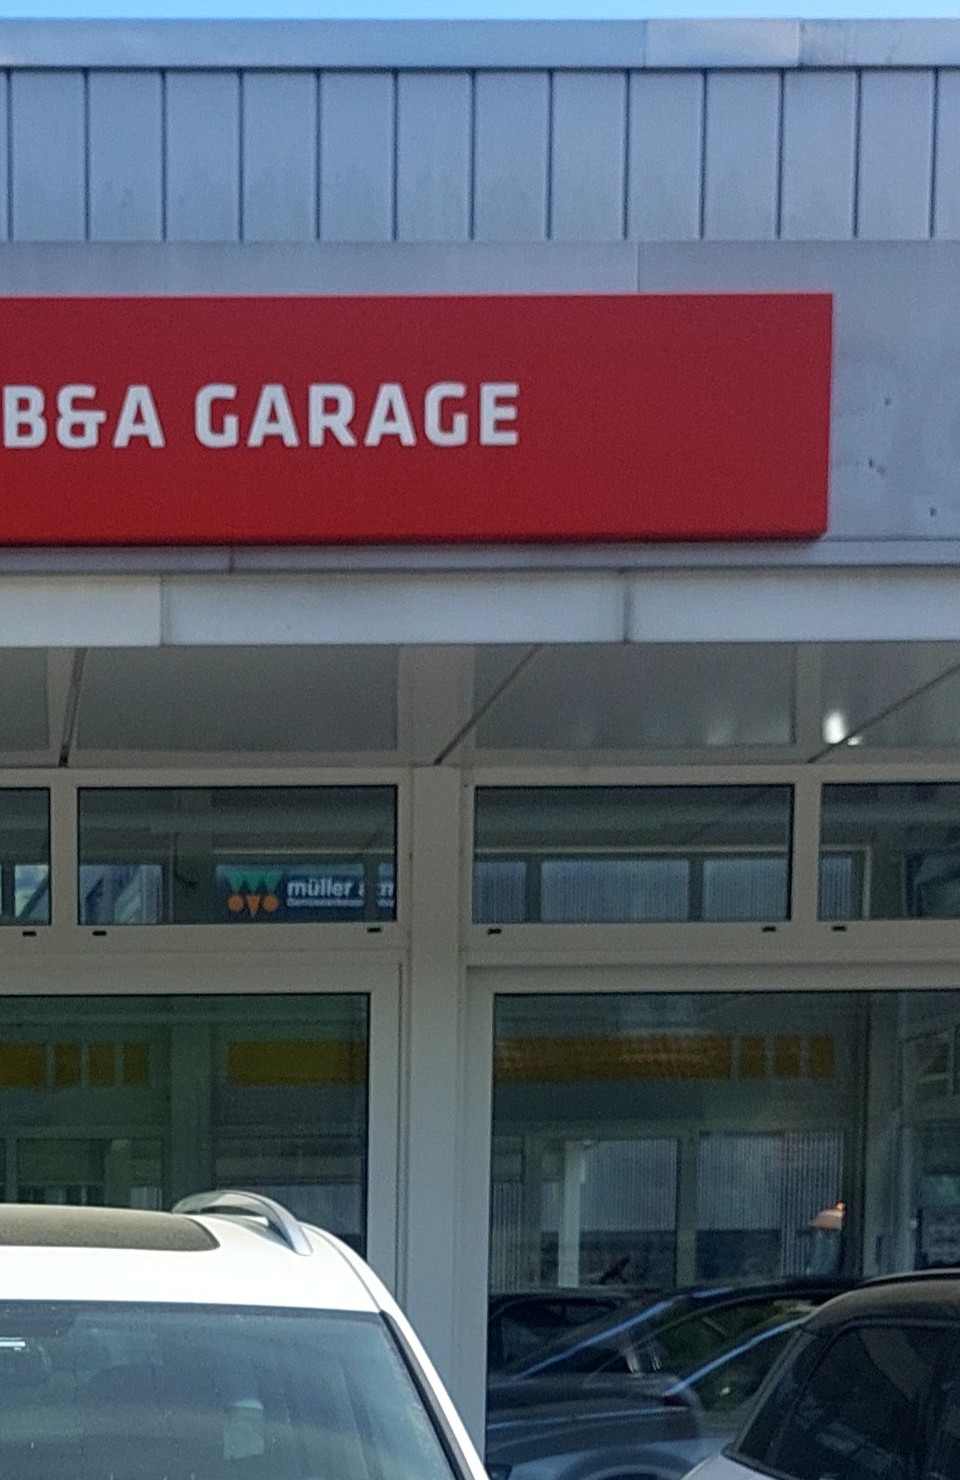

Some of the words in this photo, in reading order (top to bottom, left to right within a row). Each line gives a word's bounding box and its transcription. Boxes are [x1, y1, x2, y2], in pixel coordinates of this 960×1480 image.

[1, 383, 166, 449] B&A
[194, 382, 520, 448] GARAGE
[286, 877, 354, 897] müller
